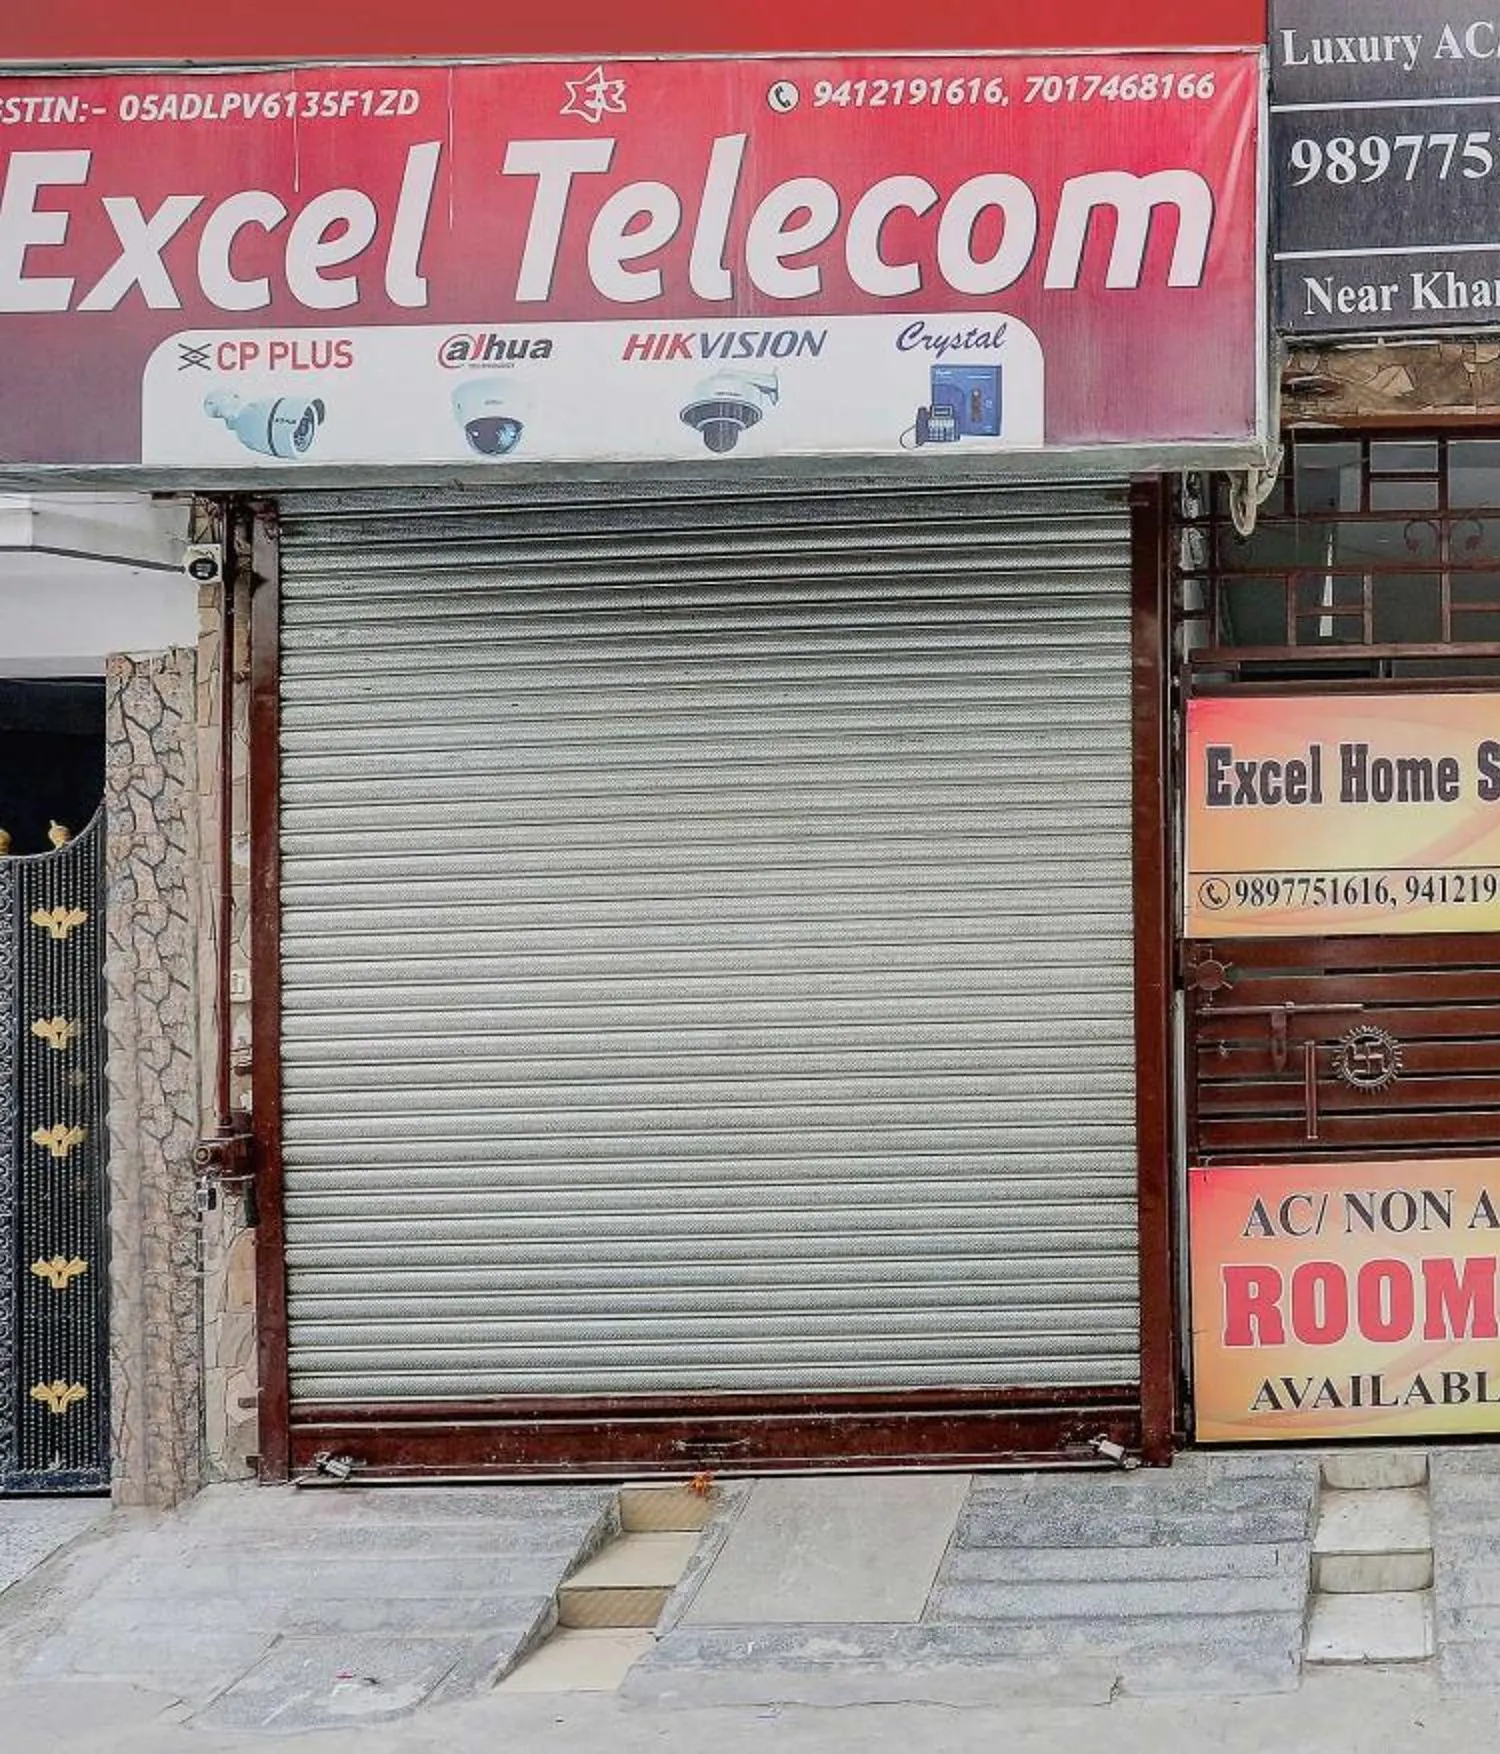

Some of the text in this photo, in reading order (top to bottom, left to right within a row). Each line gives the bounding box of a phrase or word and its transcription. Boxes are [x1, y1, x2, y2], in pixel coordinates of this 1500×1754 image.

[1279, 28, 1422, 71] Luxury
[0, 95, 107, 124] STIN:-
[812, 72, 1216, 108] 9412191616, 7017468166
[0, 131, 1216, 313] Excel Telecom
[1303, 275, 1399, 316] Near
[215, 338, 354, 372] CP PLUS
[621, 328, 828, 362] HIKVISION
[896, 320, 1008, 359] Crystal
[1205, 743, 1323, 807] Excel
[1339, 742, 1460, 803] Home
[1234, 876, 1397, 908] 9897751616,
[1242, 1191, 1329, 1238] AC/
[1343, 1187, 1455, 1234] NON
